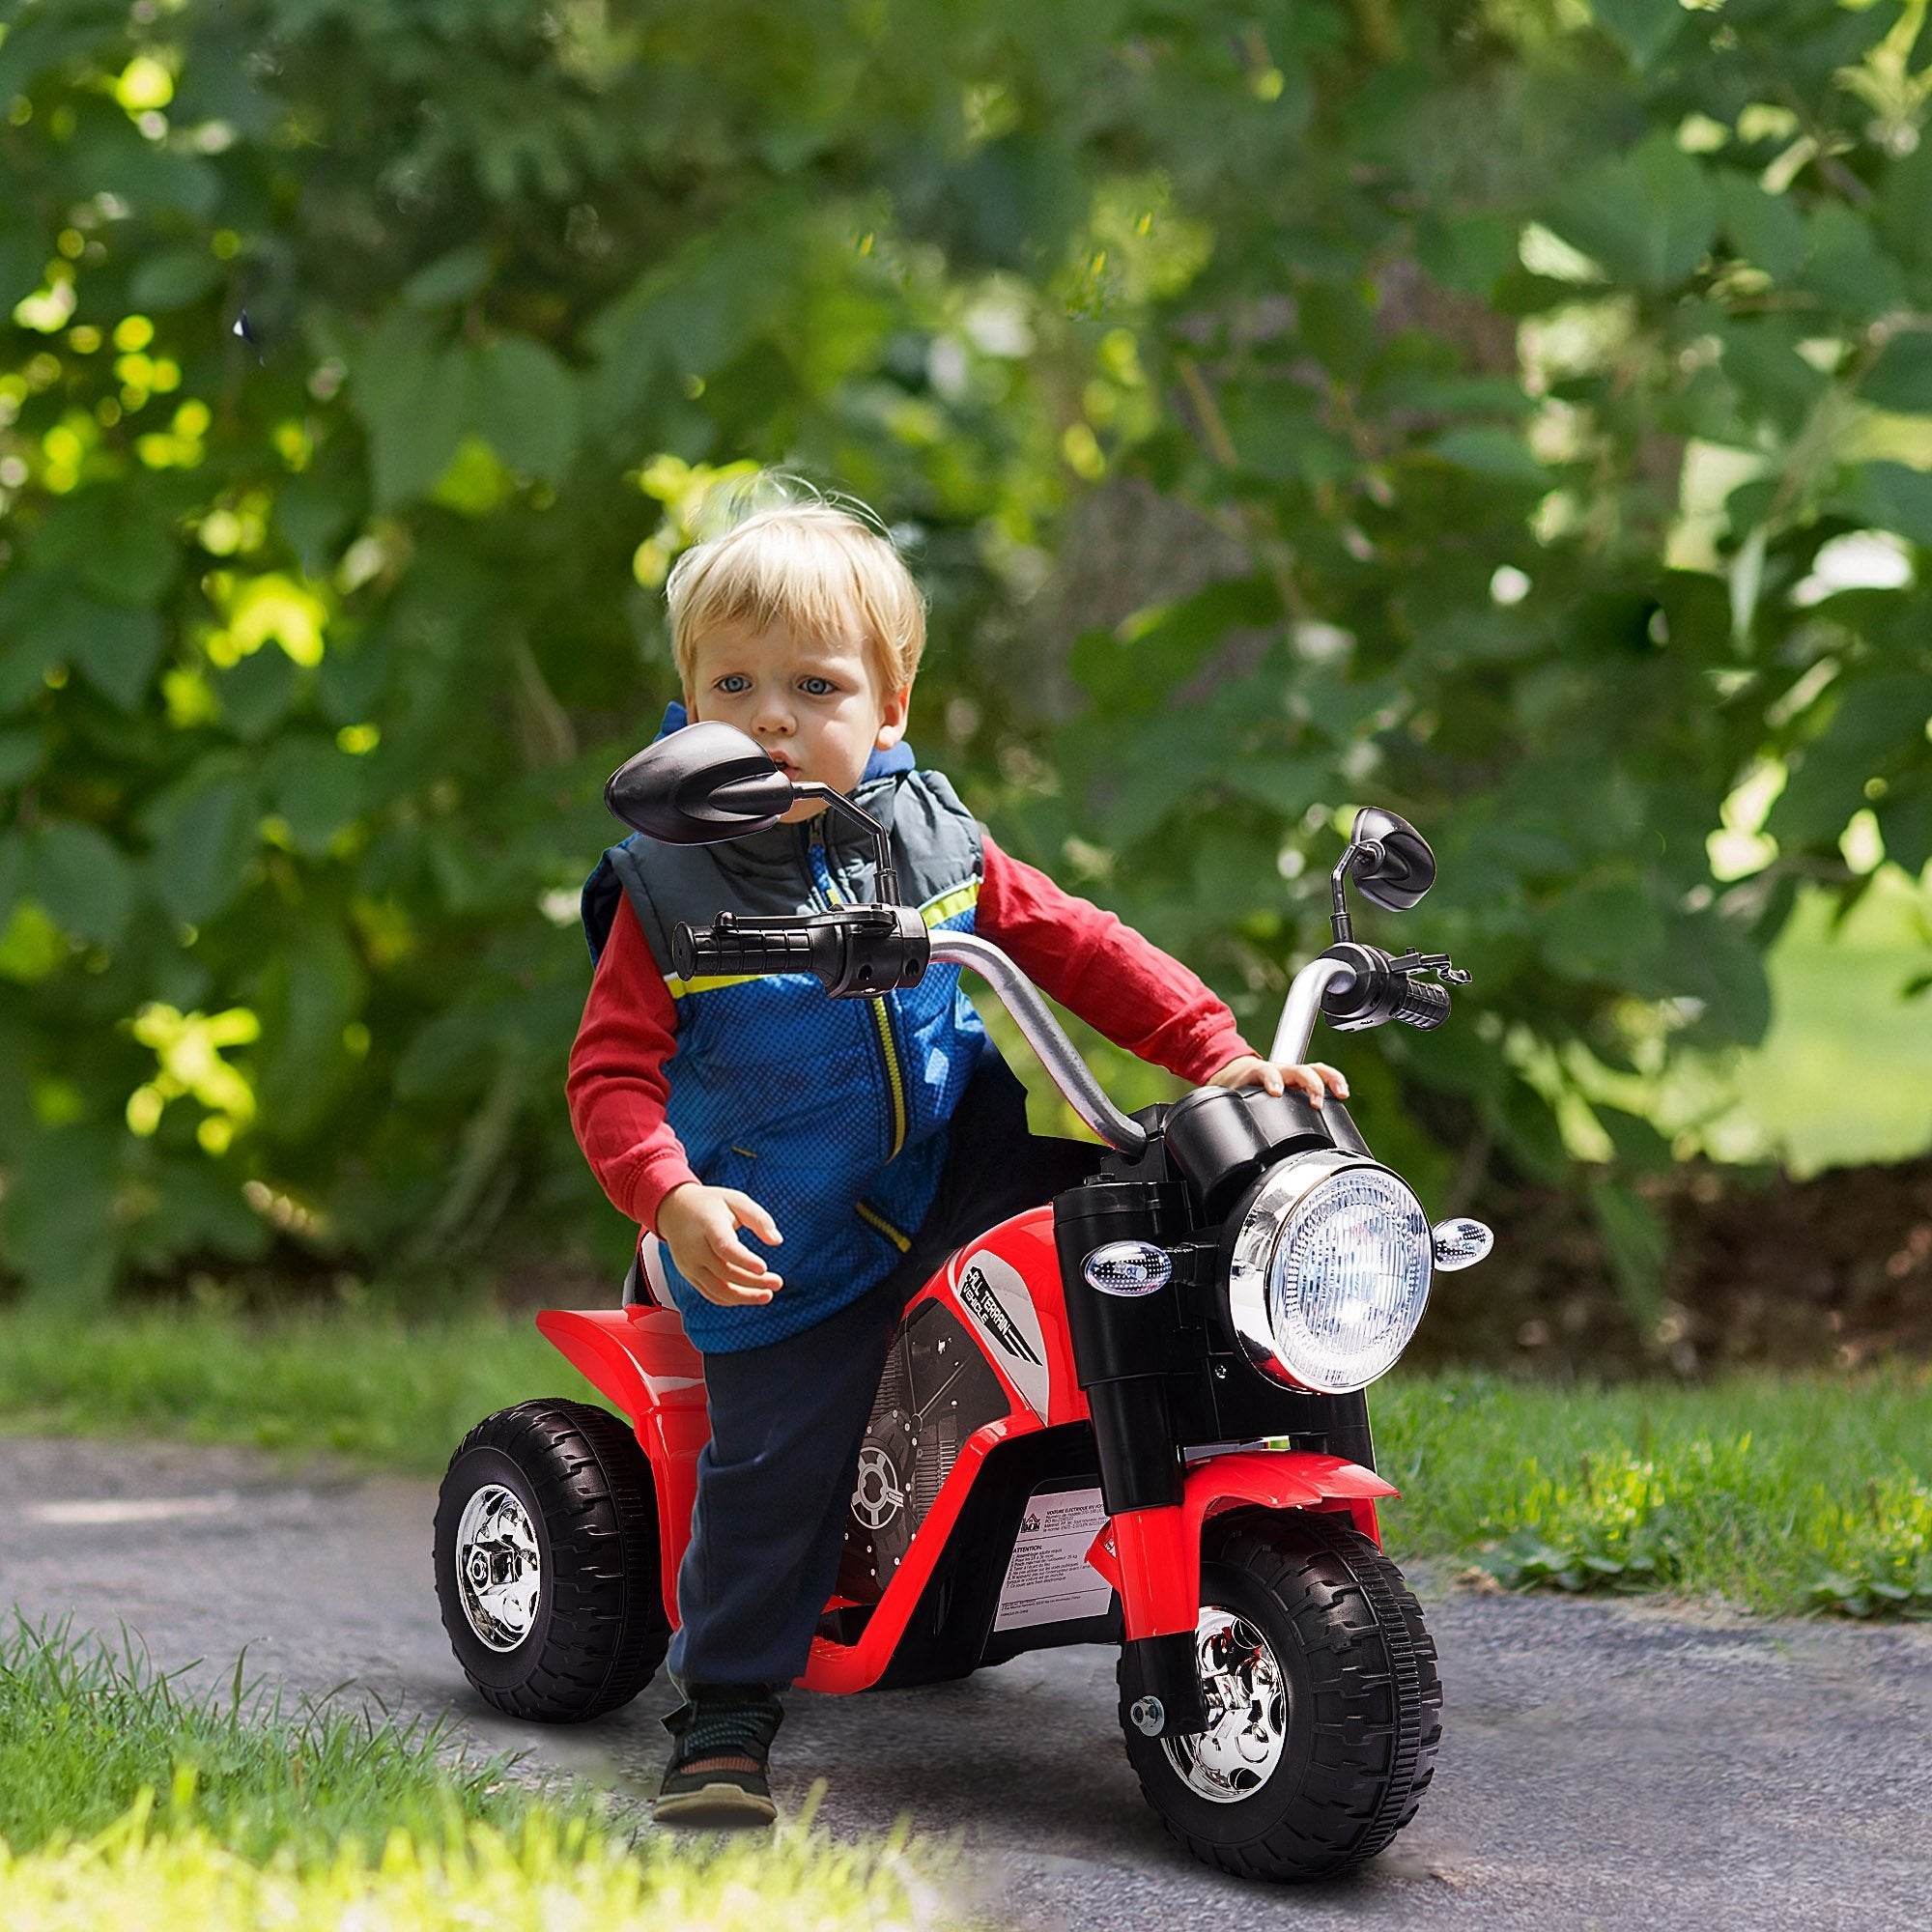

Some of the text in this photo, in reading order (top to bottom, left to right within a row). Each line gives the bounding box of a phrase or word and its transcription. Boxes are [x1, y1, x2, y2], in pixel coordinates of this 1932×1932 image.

[963, 1284, 989, 1323] VEHICLE
[969, 1271, 1010, 1335] ALL TERRAIN
